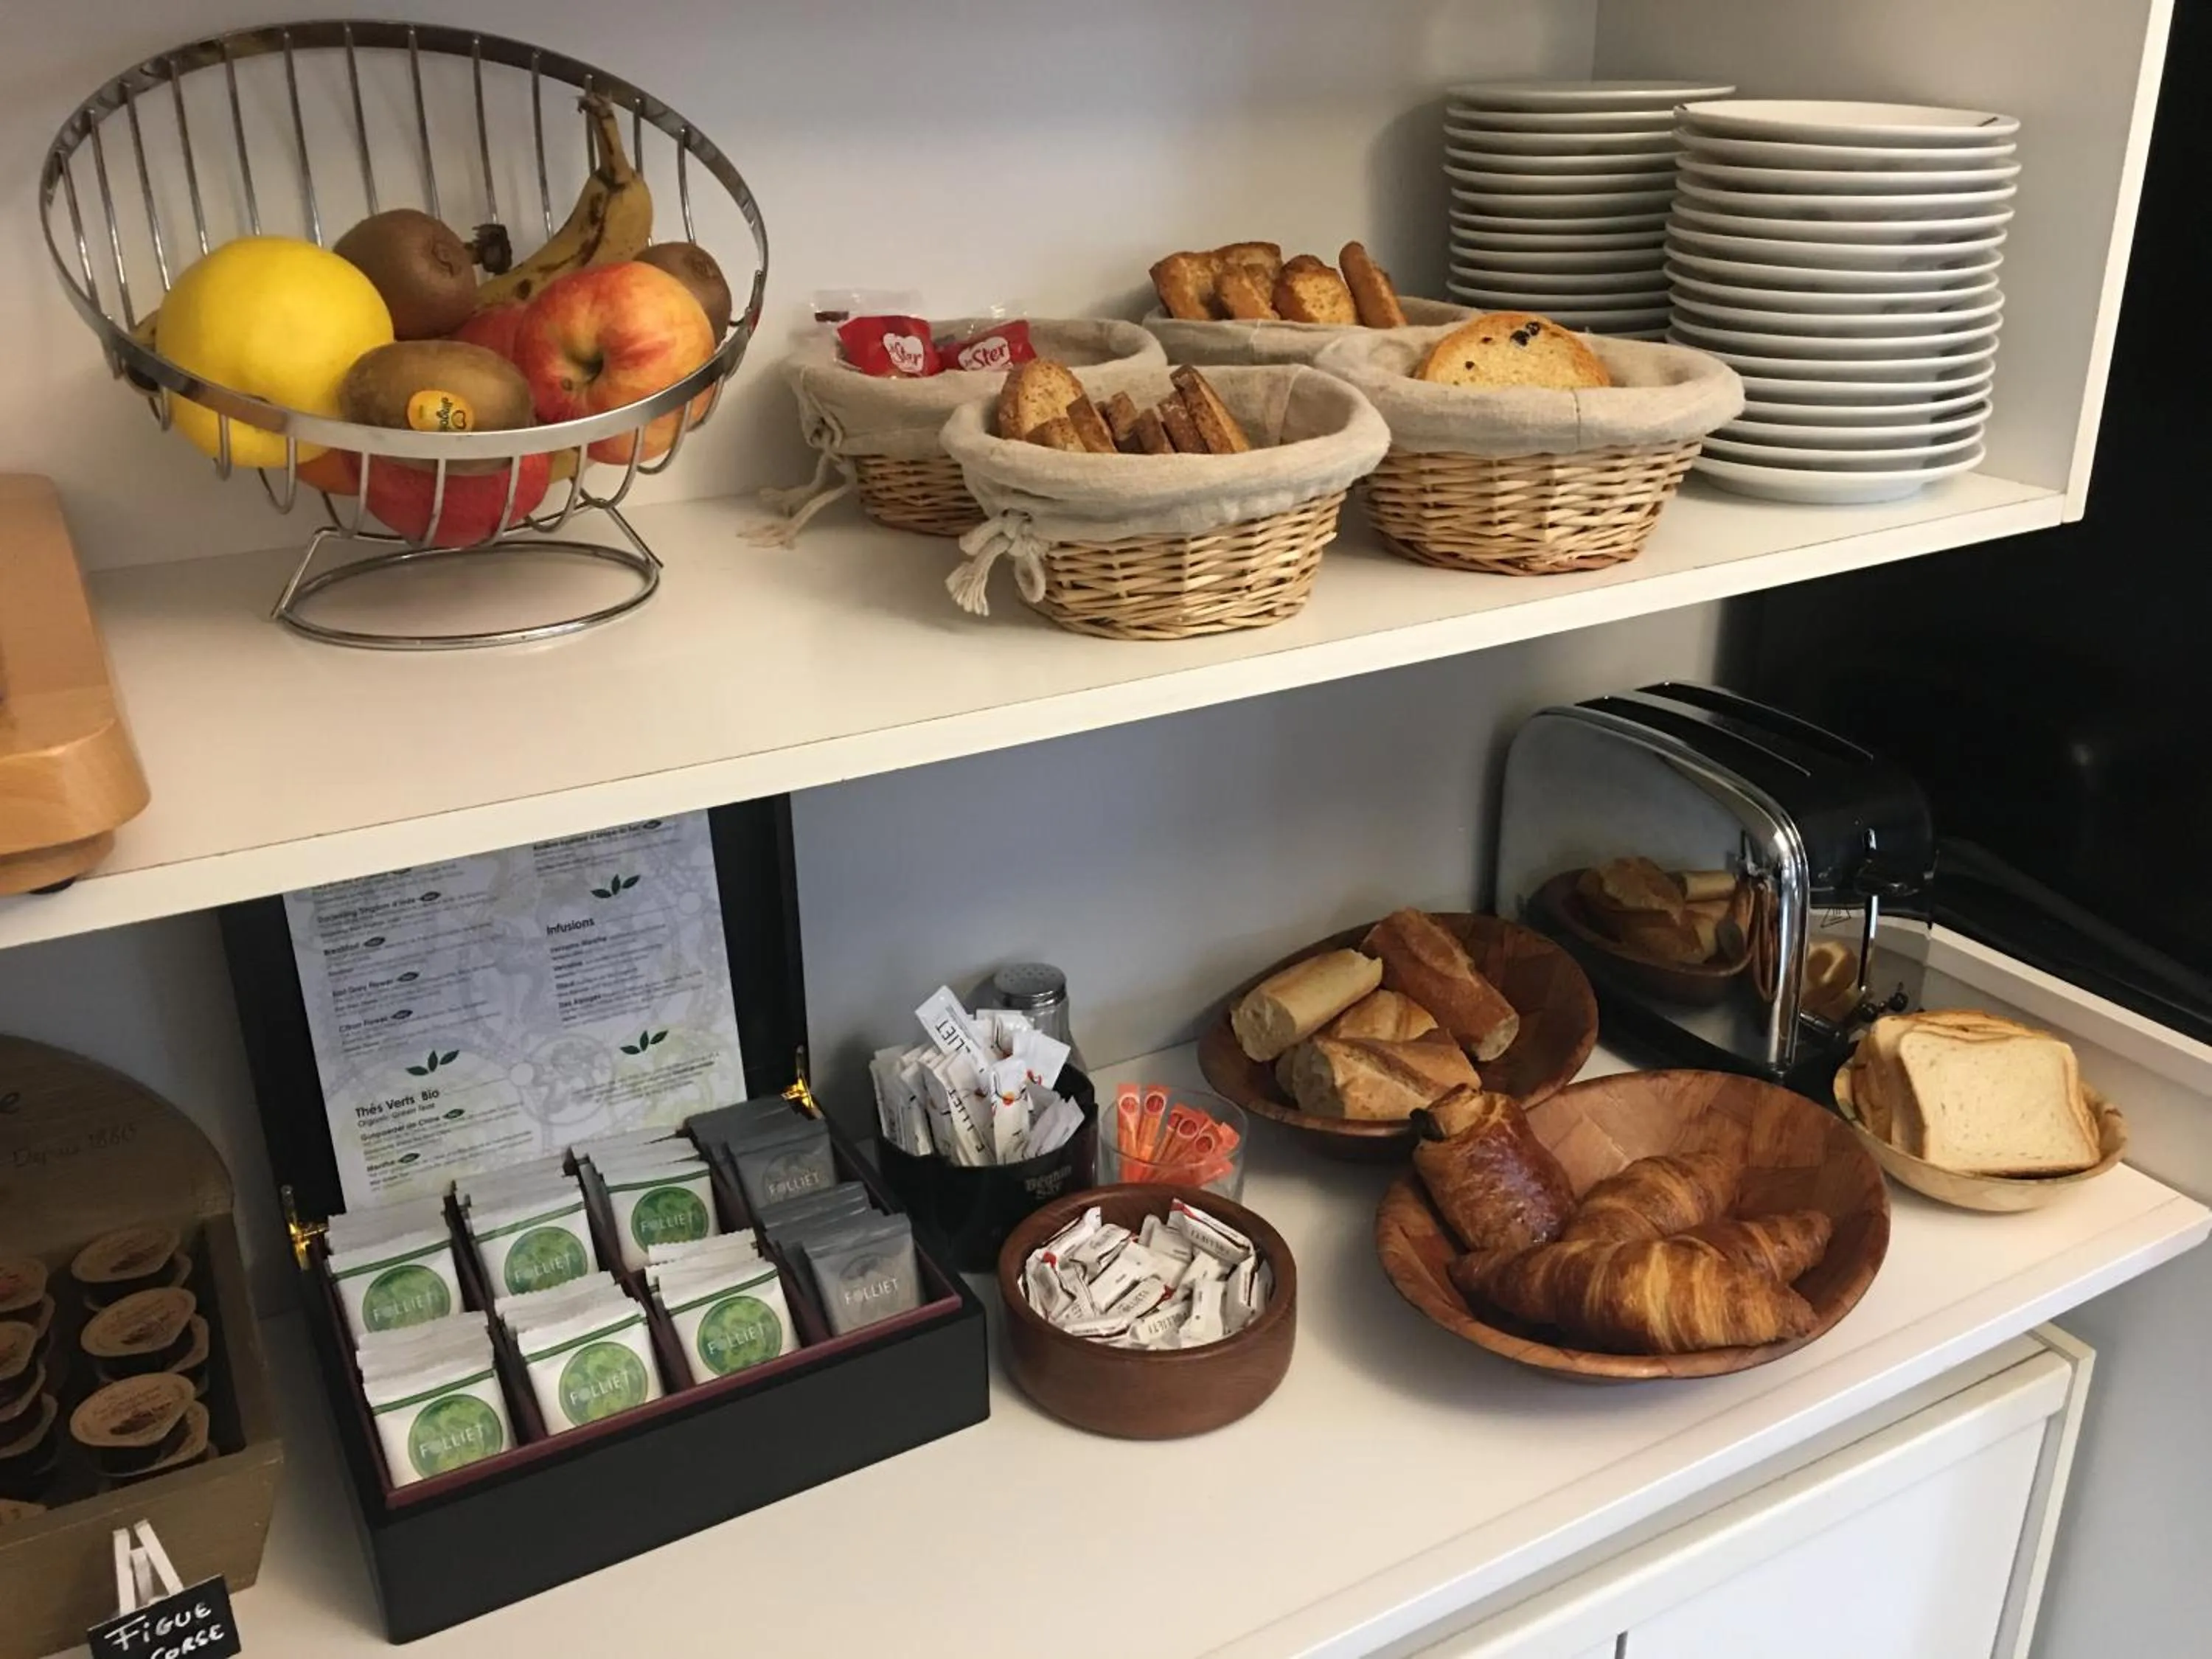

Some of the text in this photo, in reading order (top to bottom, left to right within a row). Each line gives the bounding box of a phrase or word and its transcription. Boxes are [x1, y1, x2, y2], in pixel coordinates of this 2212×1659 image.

[973, 344, 1006, 367] Ster
[546, 917, 595, 936] Infusions
[385, 1096, 415, 1110] Verts
